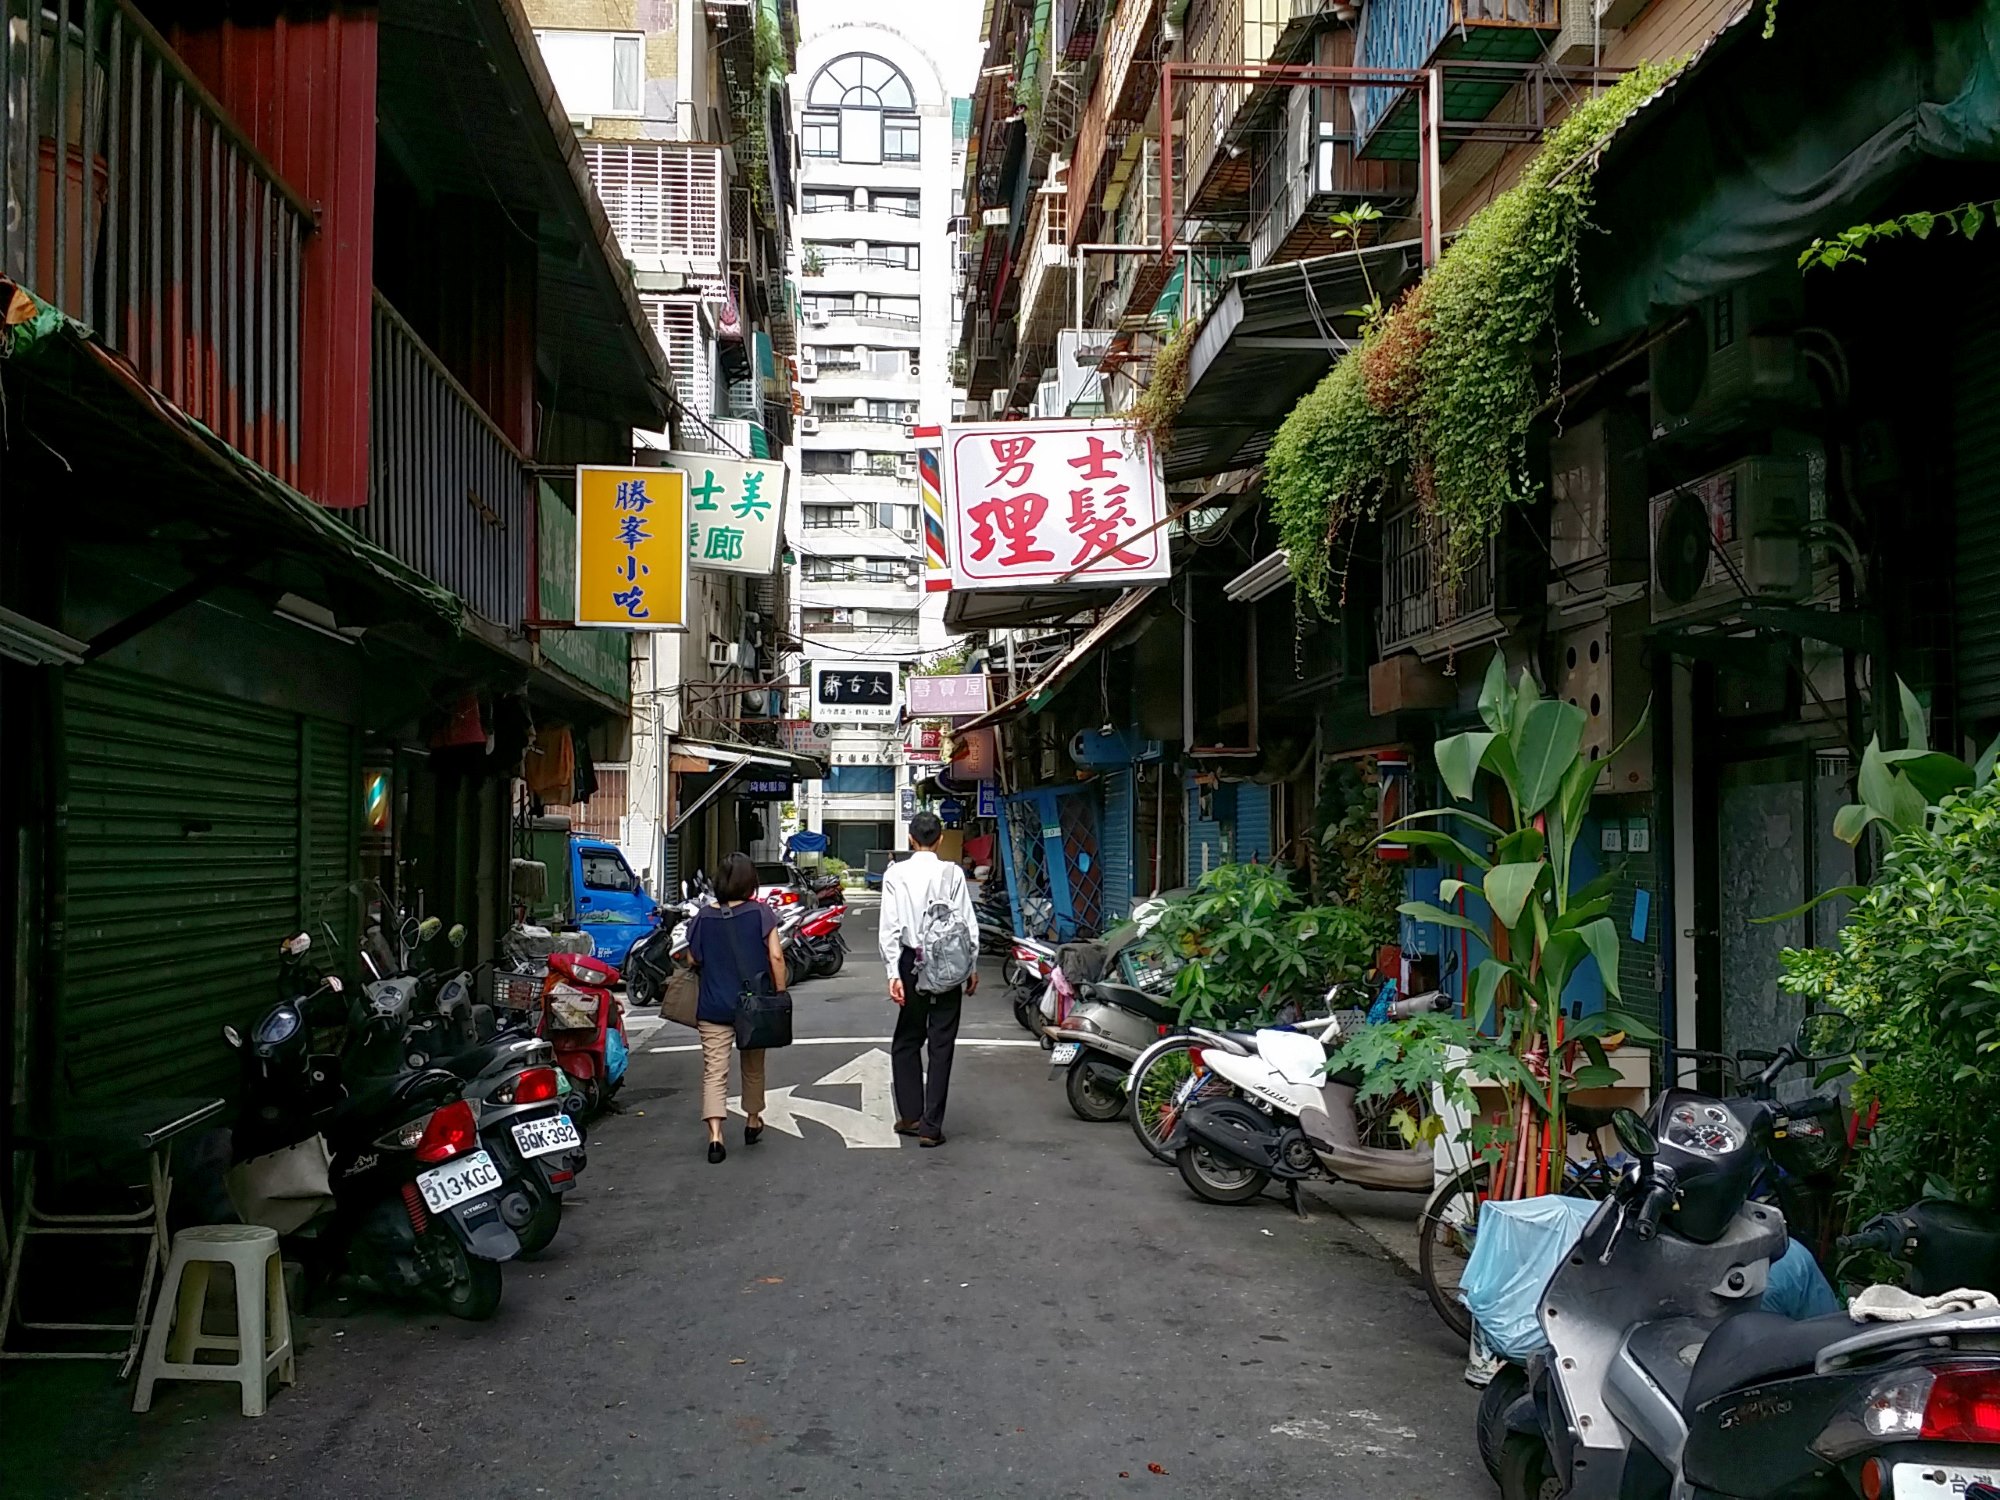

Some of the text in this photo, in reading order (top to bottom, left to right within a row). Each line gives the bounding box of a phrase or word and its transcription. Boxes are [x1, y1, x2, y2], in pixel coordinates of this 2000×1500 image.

[984, 436, 1123, 489] 男士
[612, 480, 655, 618] 勝峯小吃
[967, 485, 1150, 566] 理髮
[913, 678, 982, 697] 尋寶屋
[463, 1201, 488, 1216] KYMCO
